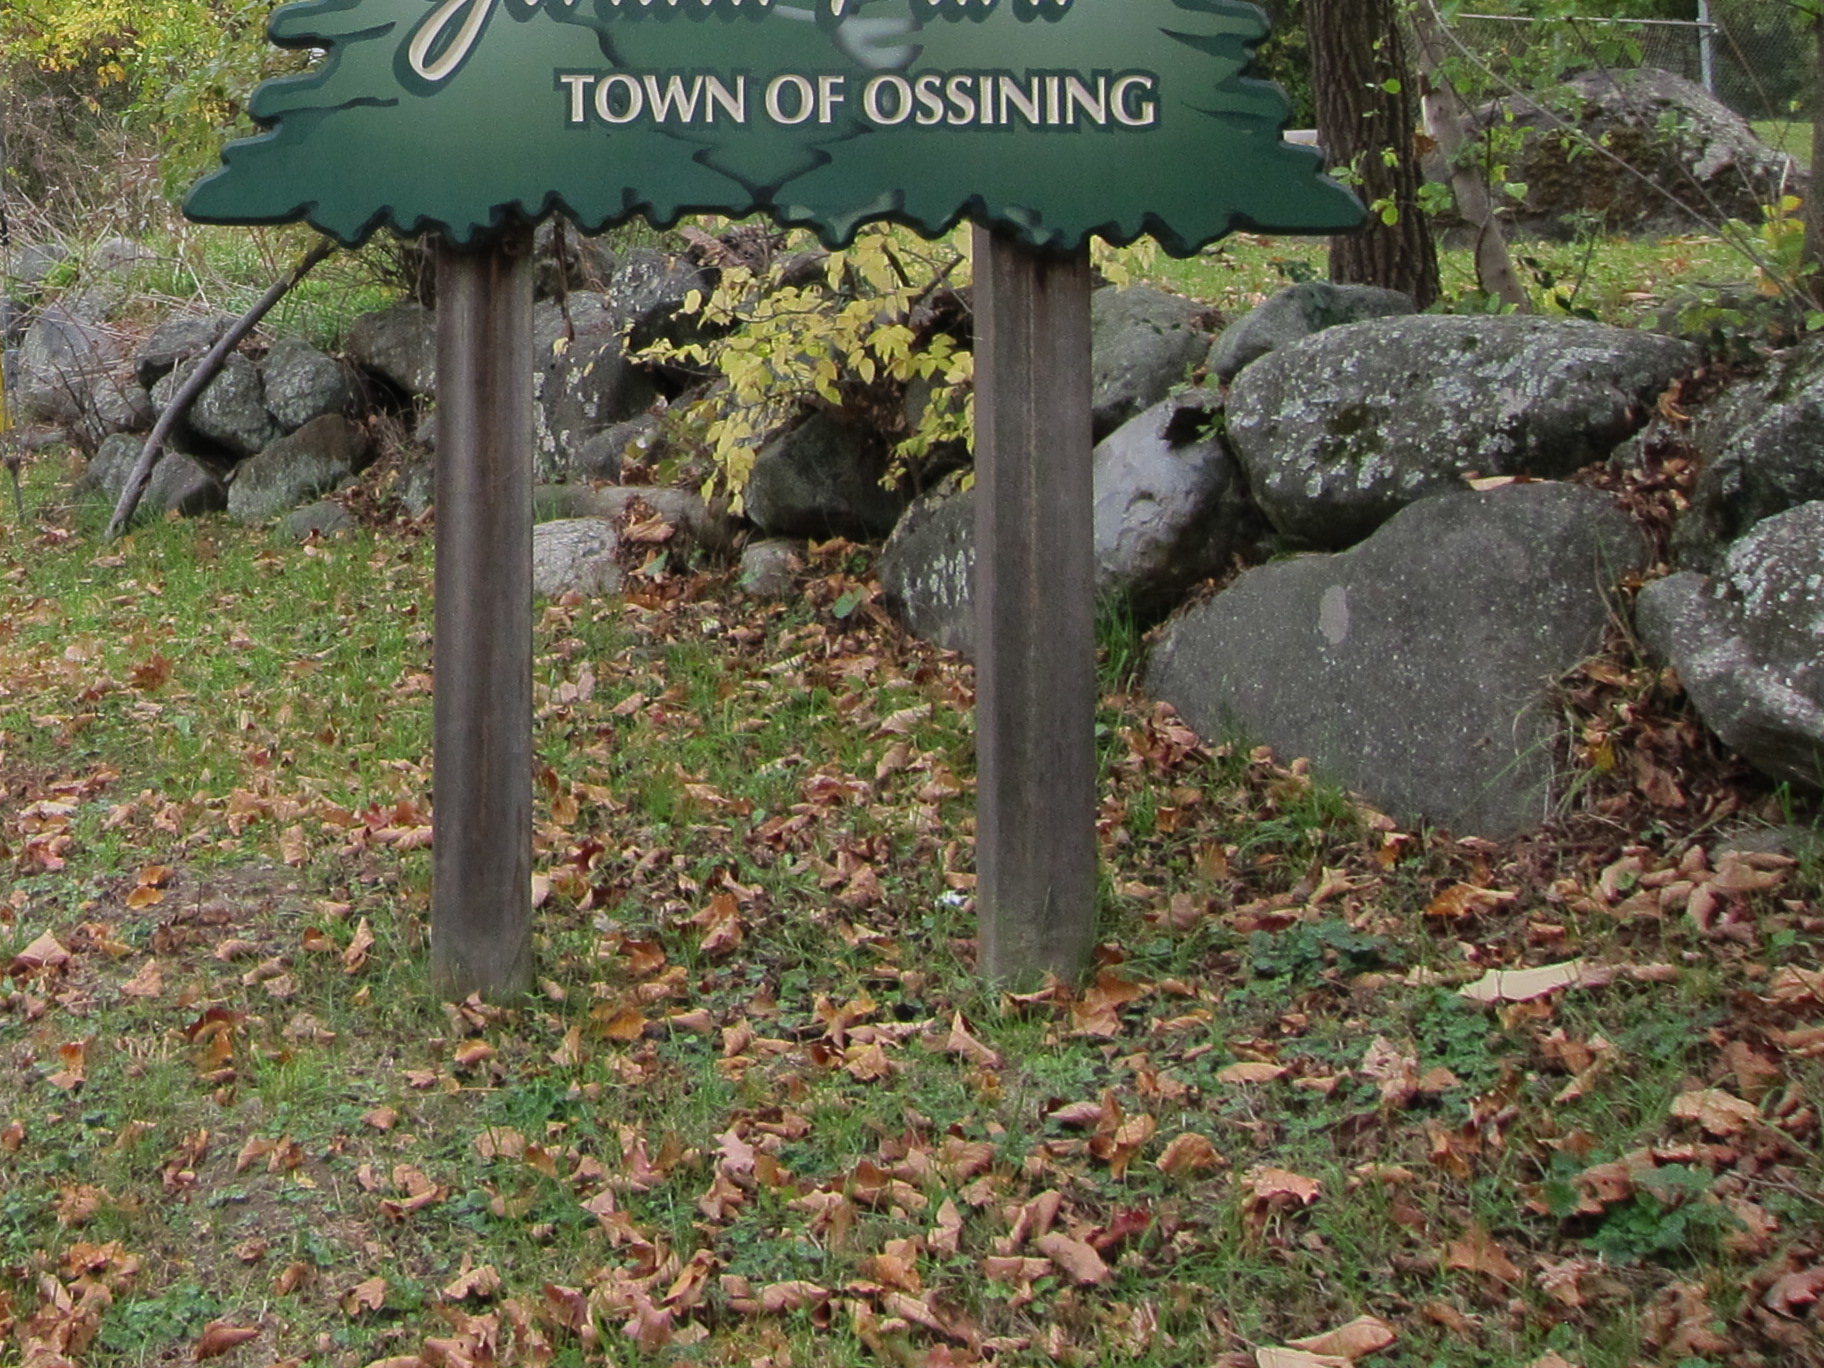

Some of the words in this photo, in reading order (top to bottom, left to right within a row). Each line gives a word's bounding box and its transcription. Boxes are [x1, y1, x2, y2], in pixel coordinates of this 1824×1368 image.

[560, 74, 745, 124] TOWN
[764, 74, 845, 124] OF
[863, 74, 1157, 125] OSSINING
